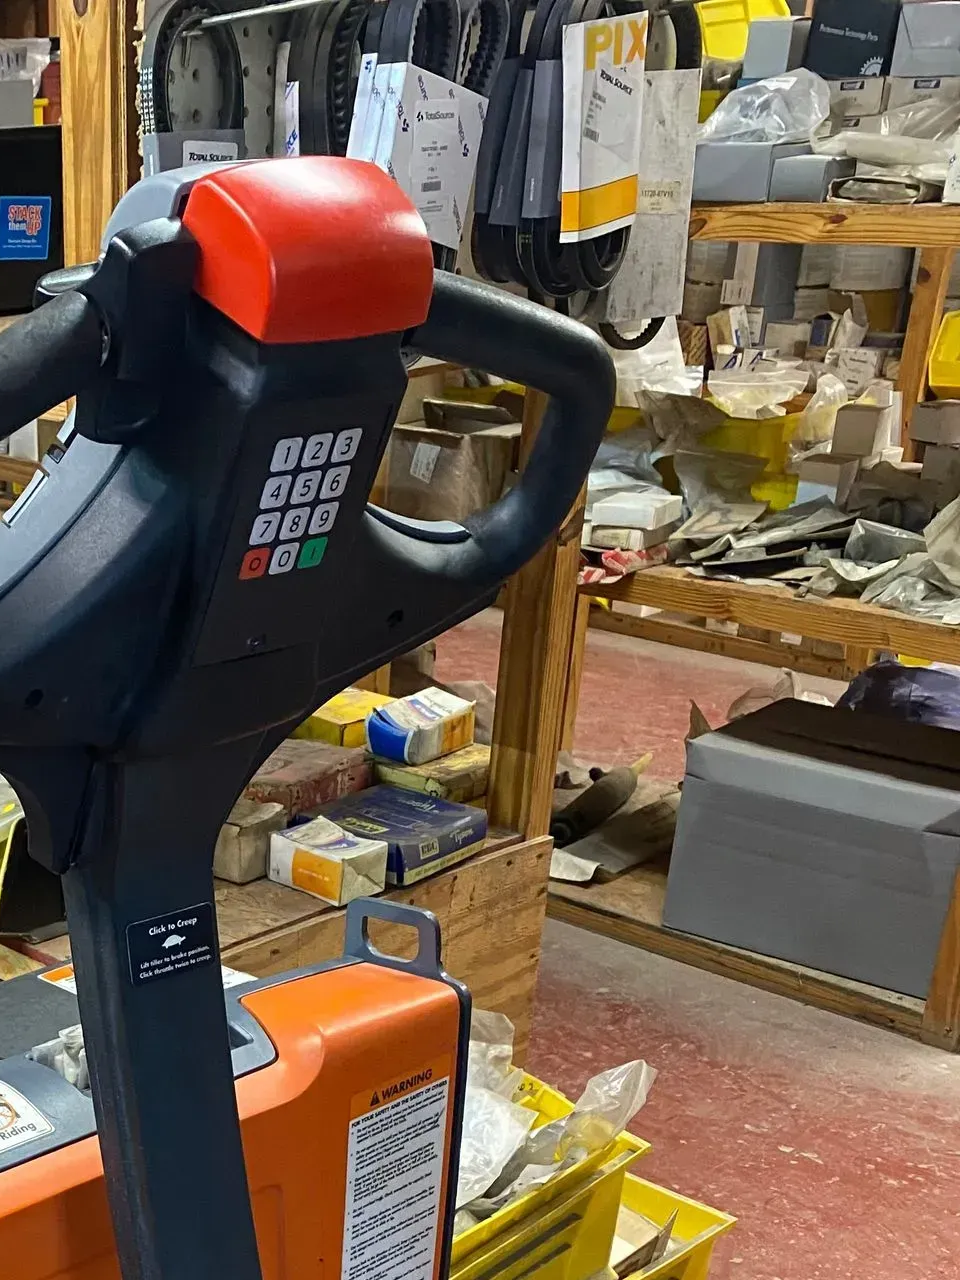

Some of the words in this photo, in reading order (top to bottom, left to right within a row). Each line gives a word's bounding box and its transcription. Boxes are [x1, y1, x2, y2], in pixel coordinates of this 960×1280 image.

[585, 18, 648, 71] PIX
[188, 152, 208, 161] TOTAL
[8, 205, 42, 220] STACK
[26, 219, 41, 236] UP
[284, 445, 292, 464] 1
[310, 441, 324, 460] 2
[340, 436, 352, 454] 3
[270, 484, 282, 501] 4
[300, 478, 312, 496] 5
[330, 474, 341, 492] 6
[260, 520, 272, 538] 7
[290, 514, 301, 532] 8
[318, 510, 330, 528] 9
[148, 924, 166, 936] Click
[177, 918, 197, 928] Creep
[140, 962, 150, 970] Lift
[150, 958, 163, 967] tiller
[171, 952, 187, 960] brake
[140, 970, 153, 979] Click
[154, 964, 174, 975] throttle
[382, 1068, 432, 1100] WARNING
[351, 1120, 360, 1128] FOR
[361, 1114, 374, 1124] YOUR
[375, 1106, 390, 1117] SAFETY
[409, 1091, 424, 1101] SAFETY
